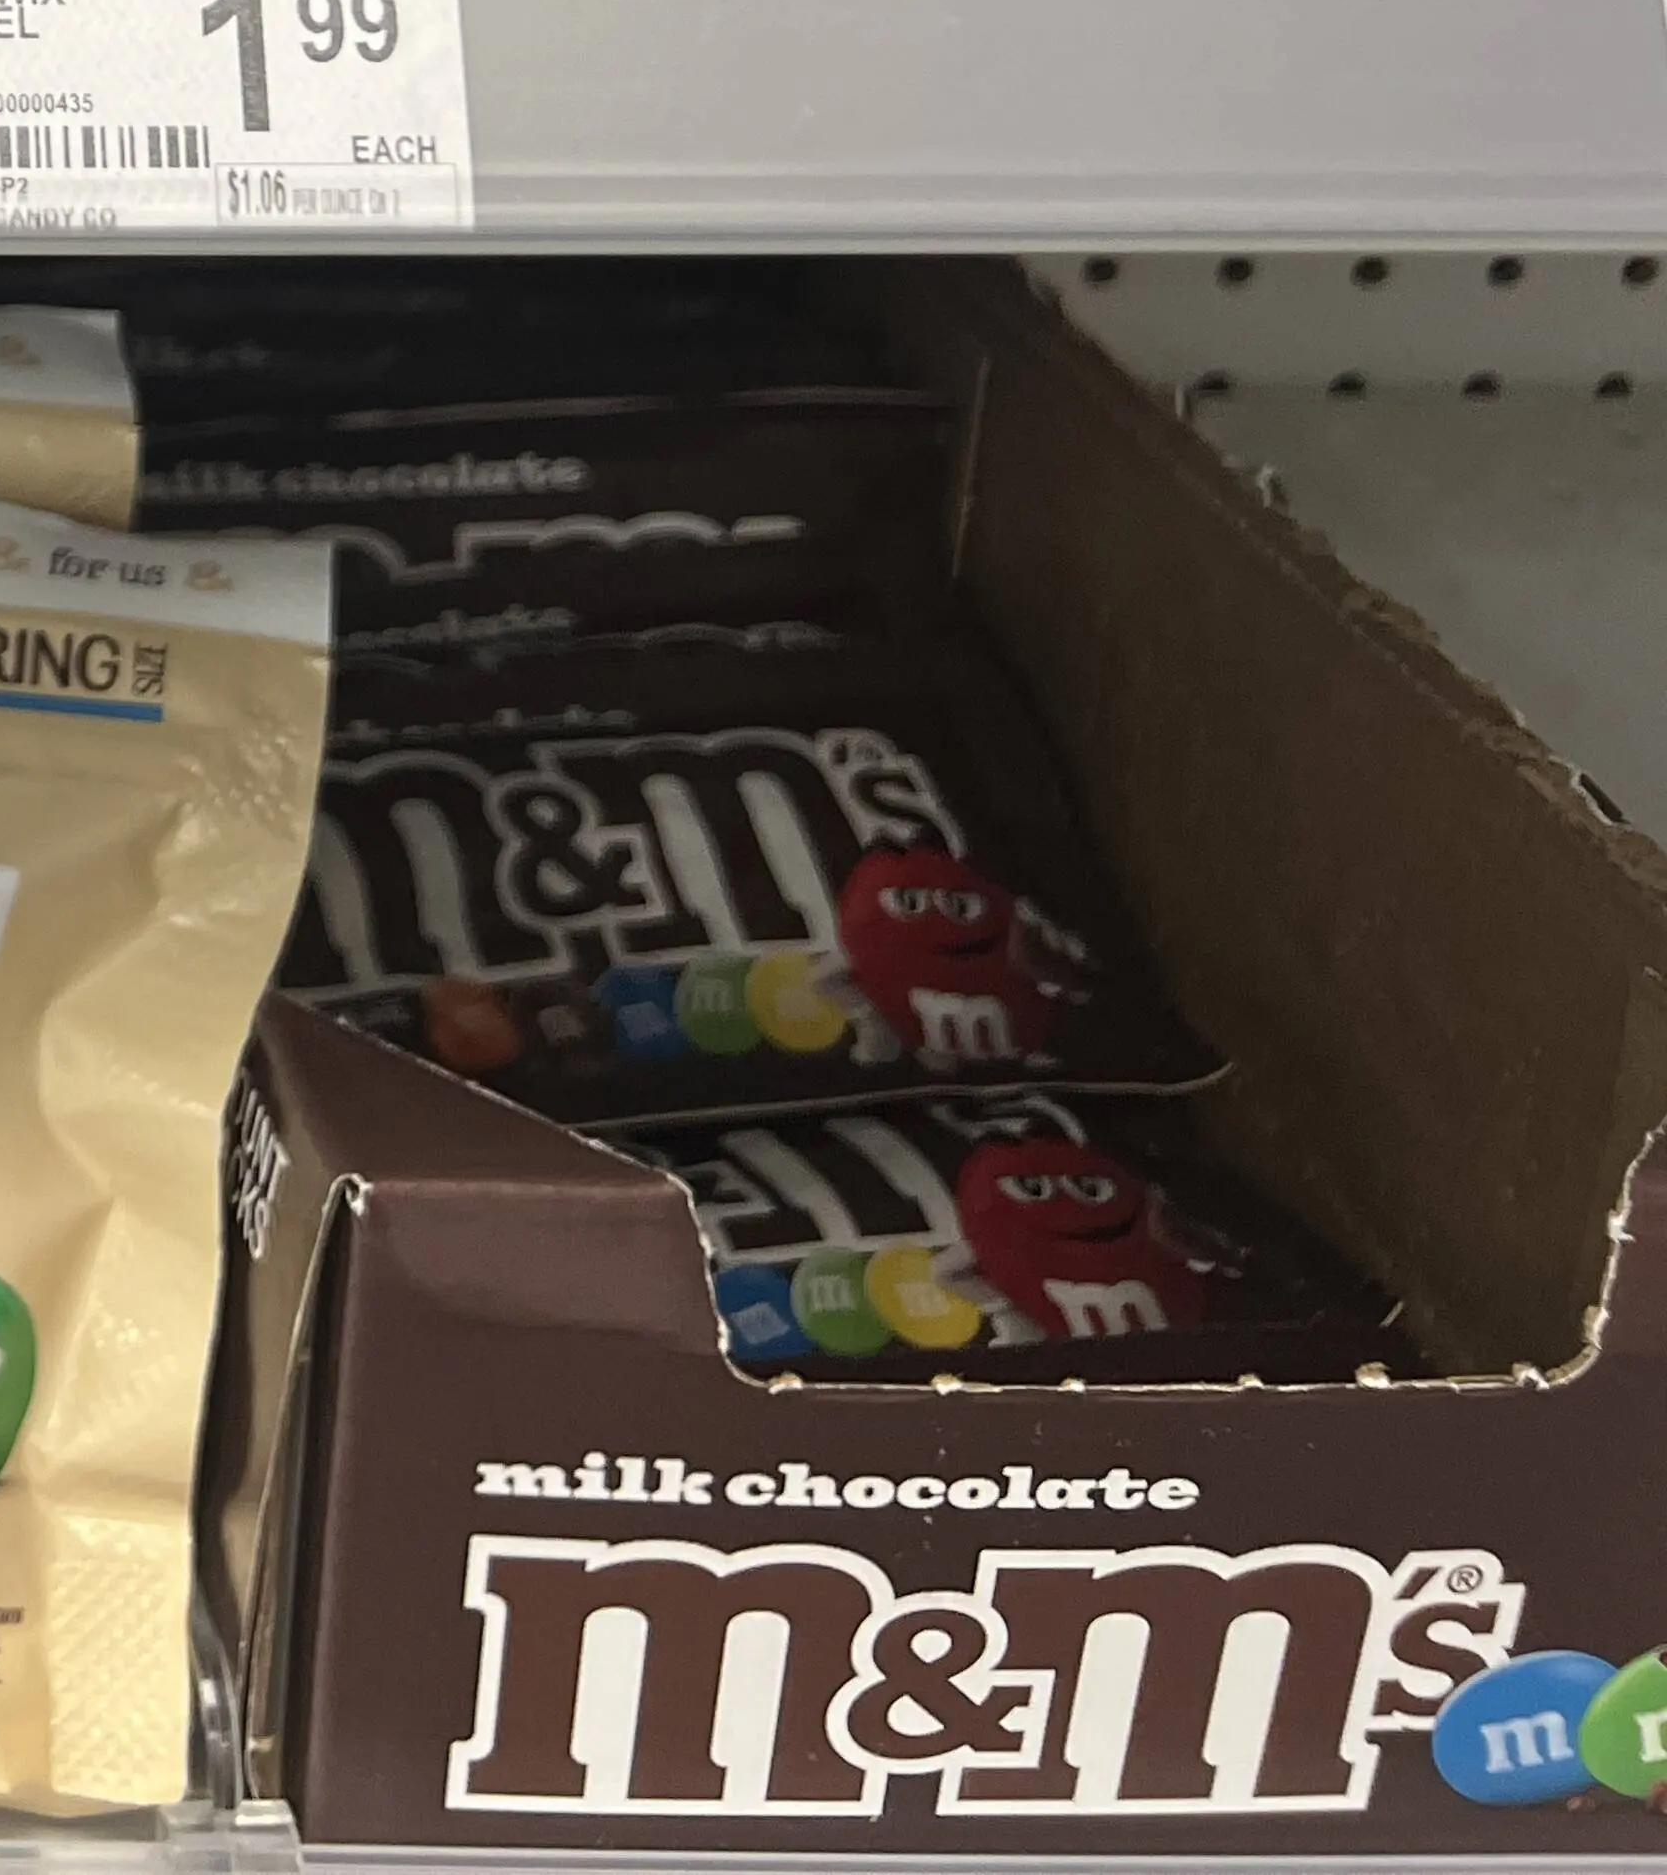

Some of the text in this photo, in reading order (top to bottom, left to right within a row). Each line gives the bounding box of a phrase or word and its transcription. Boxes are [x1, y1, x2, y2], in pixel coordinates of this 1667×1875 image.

[351, 134, 437, 163] EACH
[227, 168, 287, 220] $1.06
[46, 545, 110, 582] for
[118, 557, 169, 589] us
[473, 1456, 1202, 1511] milk chocolate
